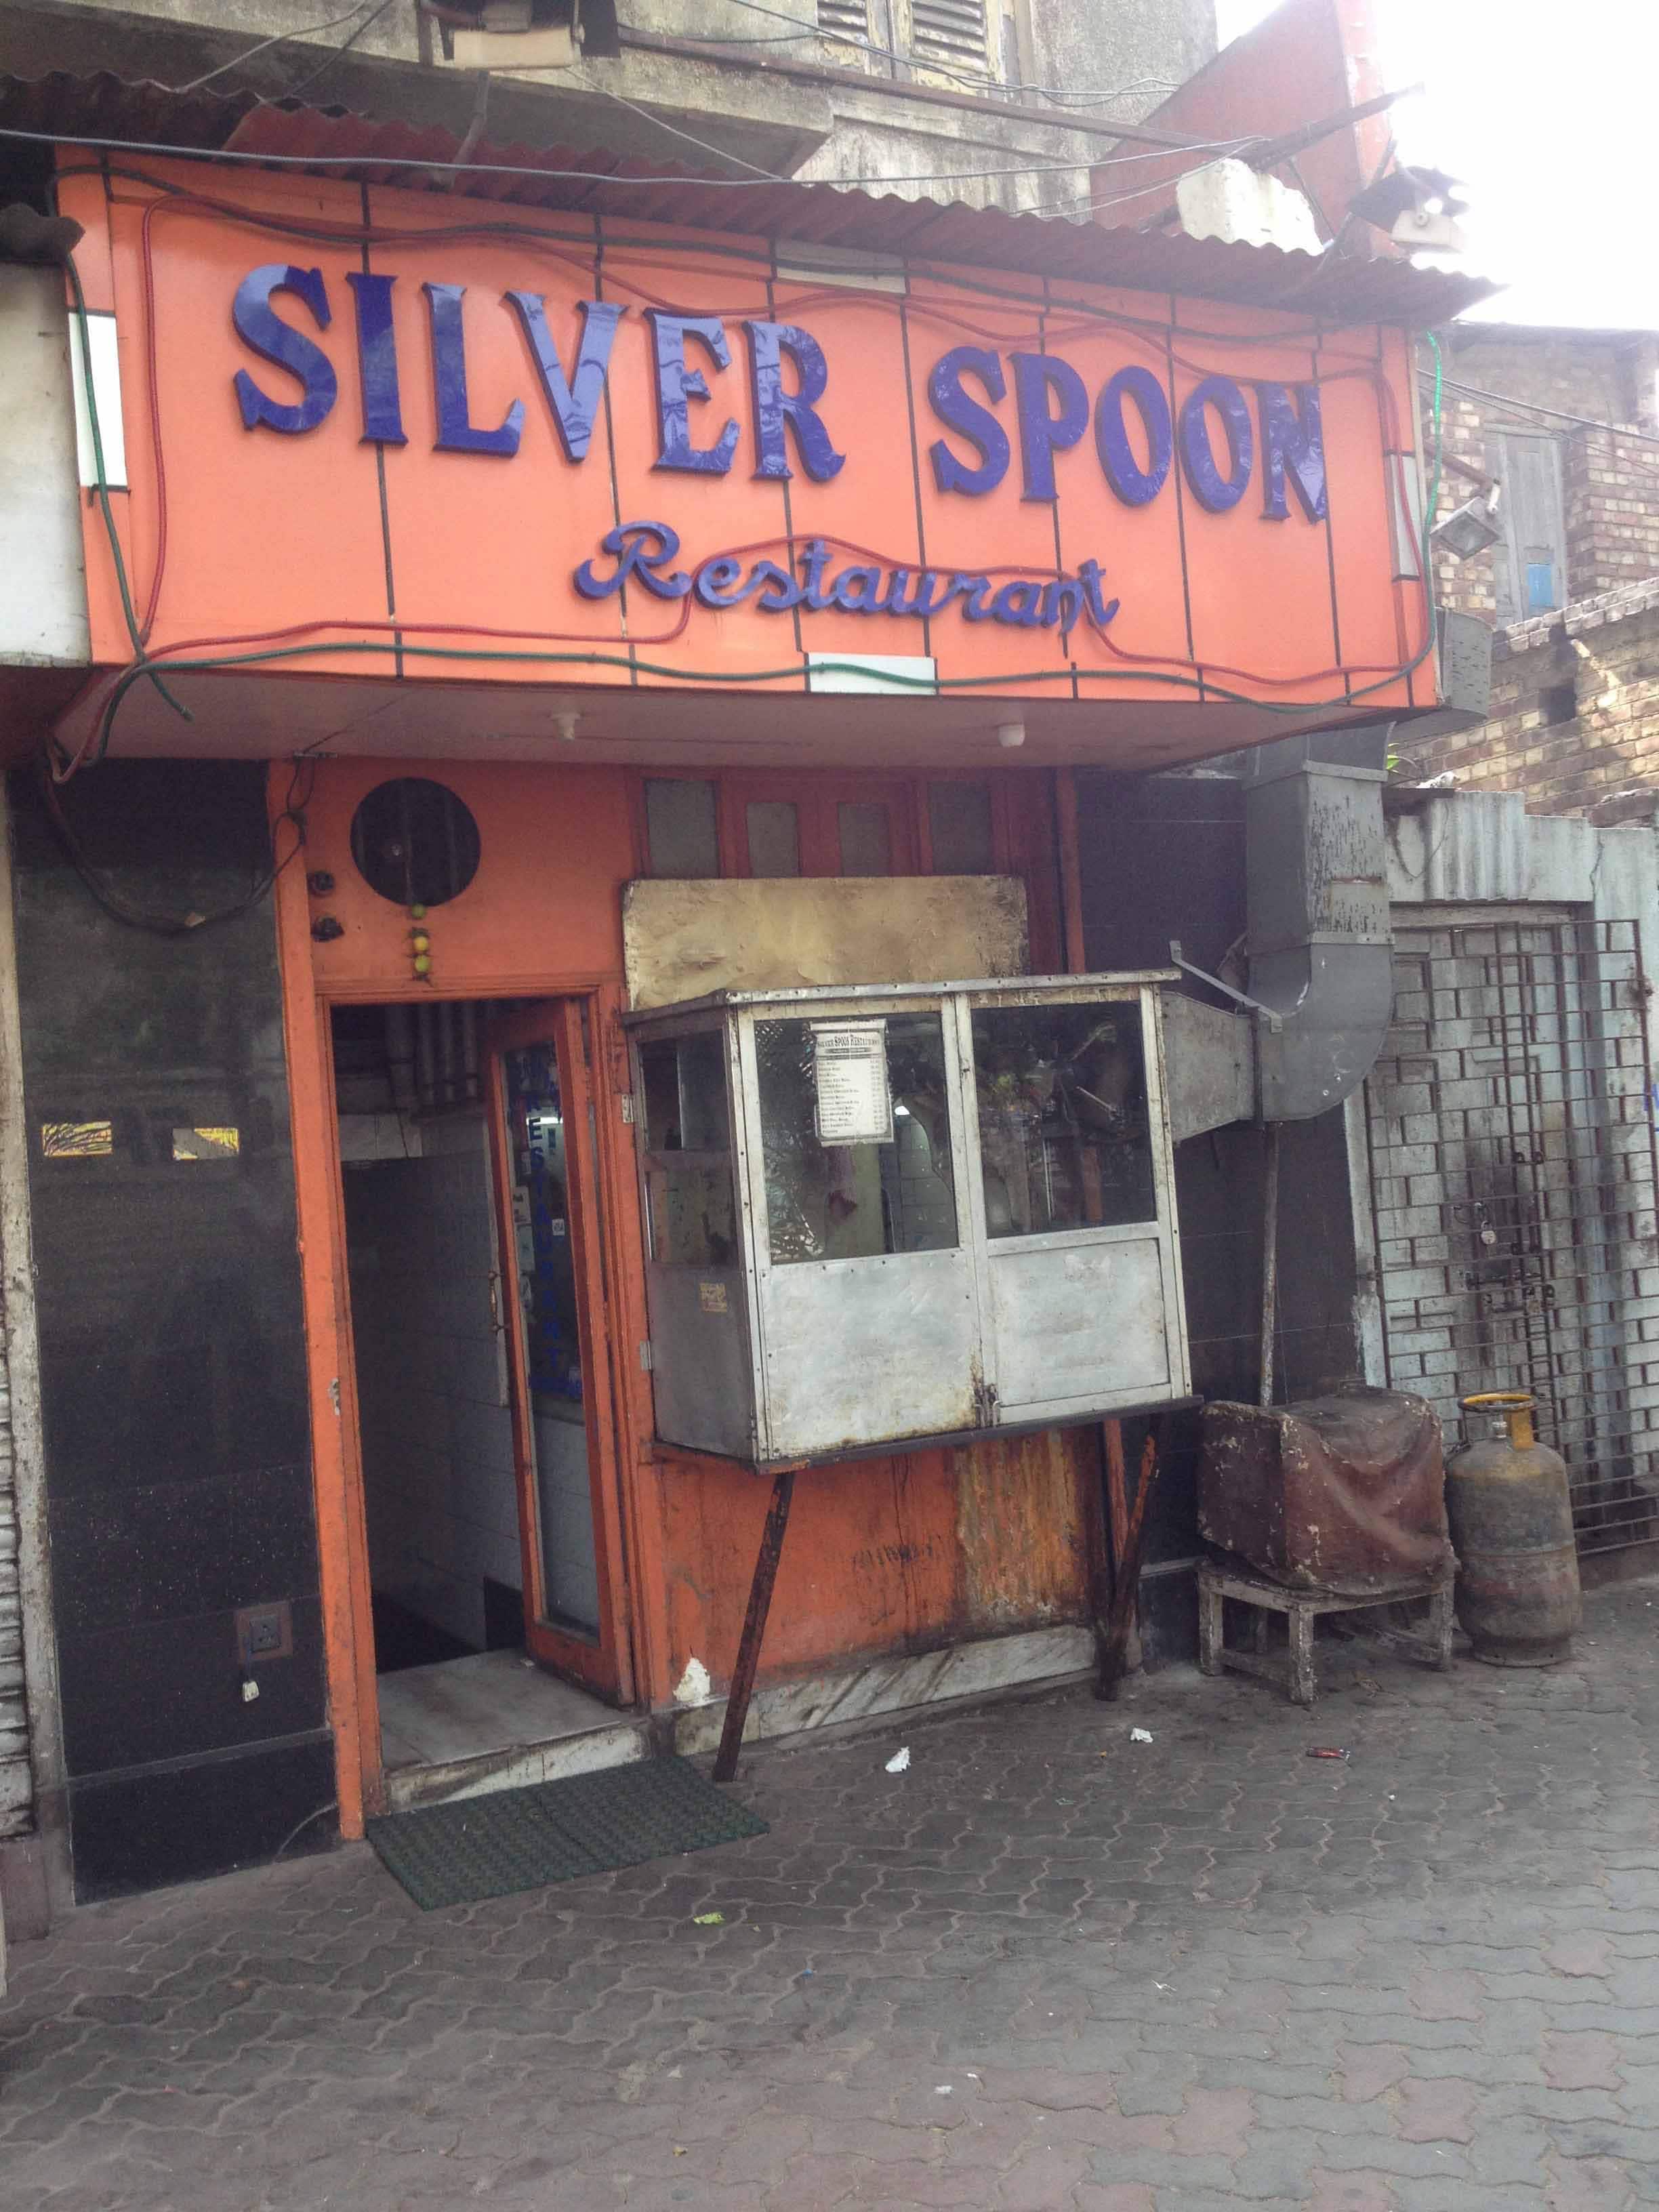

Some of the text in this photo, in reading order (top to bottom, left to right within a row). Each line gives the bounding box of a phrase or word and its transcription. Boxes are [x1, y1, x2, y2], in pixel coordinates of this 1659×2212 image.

[231, 263, 1328, 525] SILVER SPOON
[573, 520, 1121, 636] Restaurant
